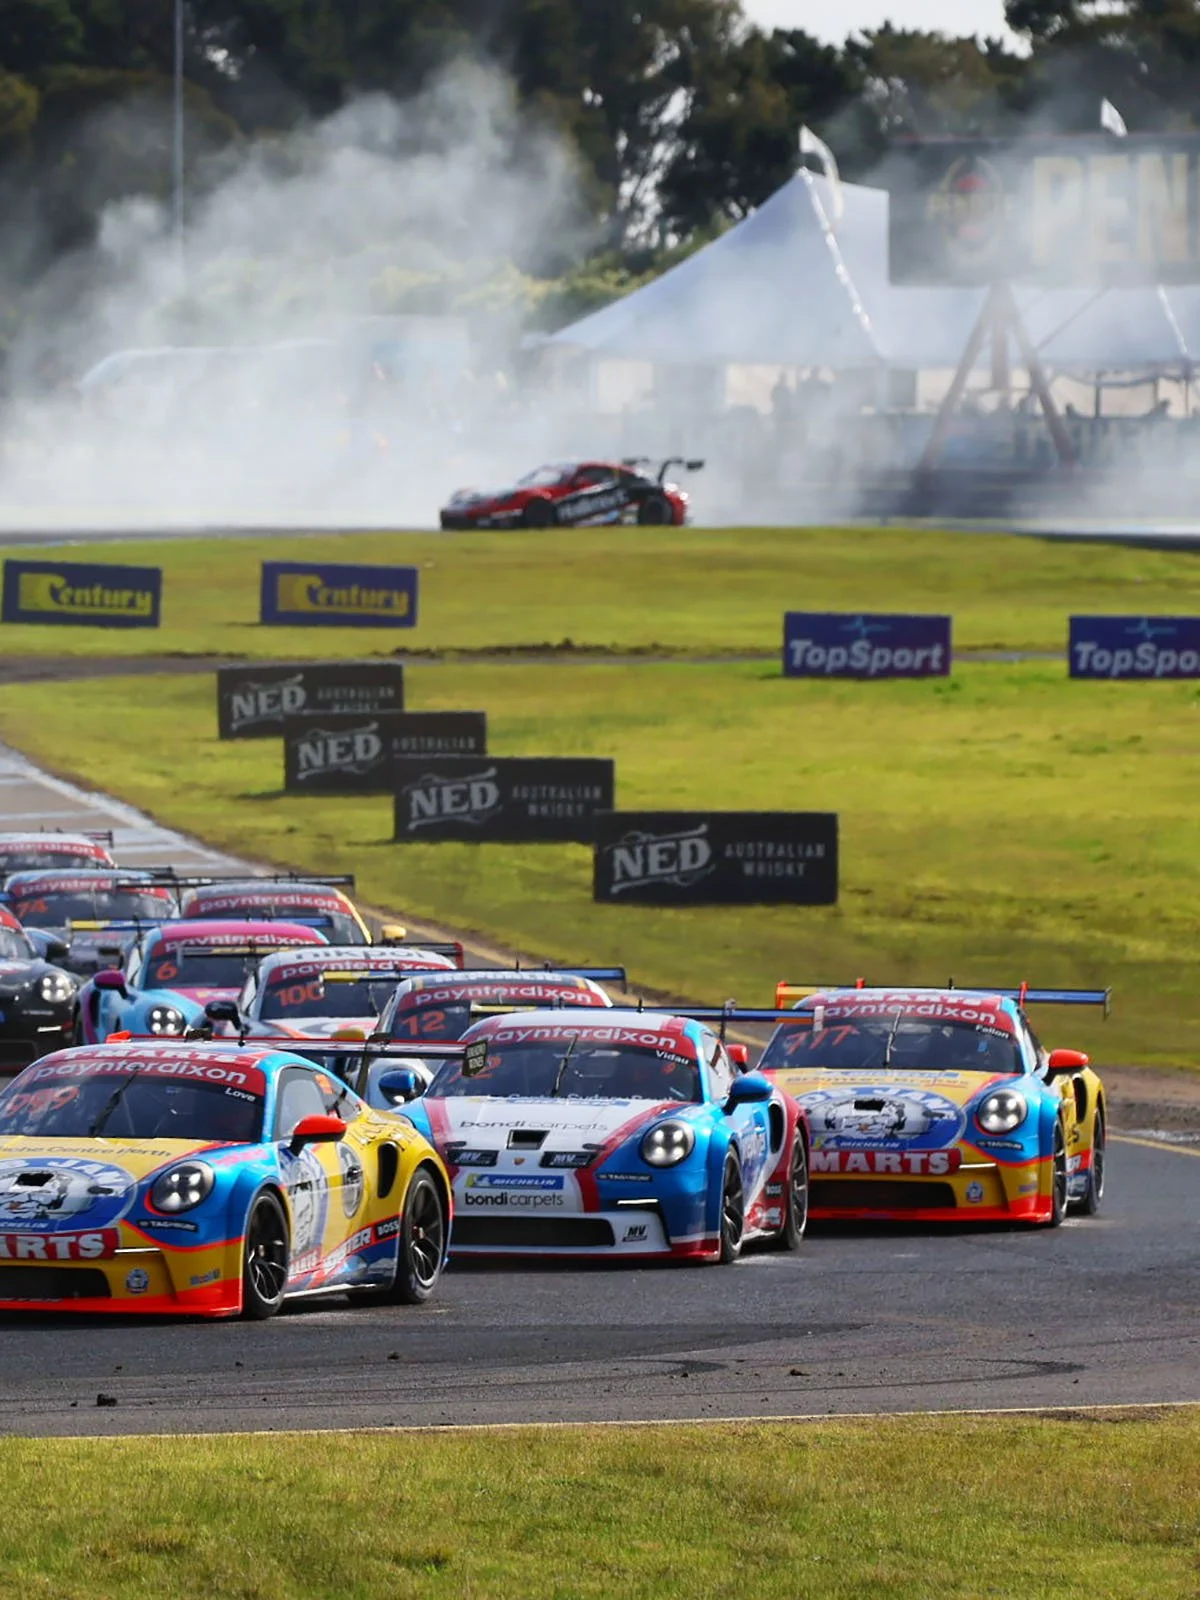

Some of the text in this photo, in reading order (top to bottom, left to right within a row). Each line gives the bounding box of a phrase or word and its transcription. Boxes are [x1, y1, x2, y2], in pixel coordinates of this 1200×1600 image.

[1032, 155, 1200, 262] PEN
[36, 573, 152, 616] Century
[294, 574, 409, 616] Century
[788, 639, 945, 675] TopSport
[1073, 641, 1200, 678] TopSpo
[230, 681, 307, 720] NED
[297, 731, 383, 772] NED
[392, 736, 476, 750] AUSTRALIAN
[409, 780, 500, 818] NED
[511, 786, 602, 800] AUSTRALIAN
[528, 803, 584, 817] WHISKY
[612, 836, 712, 882] NED
[724, 845, 826, 858] AUSTRALIAN
[743, 862, 805, 877] WHISKY
[199, 893, 341, 913] paynterdixon
[156, 961, 177, 981] 6
[281, 960, 440, 980] paynterdx
[276, 980, 325, 1007] 100
[415, 983, 593, 1005] paynterdixon
[402, 1010, 446, 1035] 12
[822, 1003, 997, 1025] aynterdixon
[975, 1024, 1010, 1039] Fallon
[655, 1049, 690, 1066] Vidau
[31, 1058, 248, 1085] paynterdixon
[224, 1087, 256, 1102] Love
[810, 1151, 950, 1173] MARTS
[492, 1178, 557, 1186] MICHELIN
[627, 1225, 647, 1237] MV
